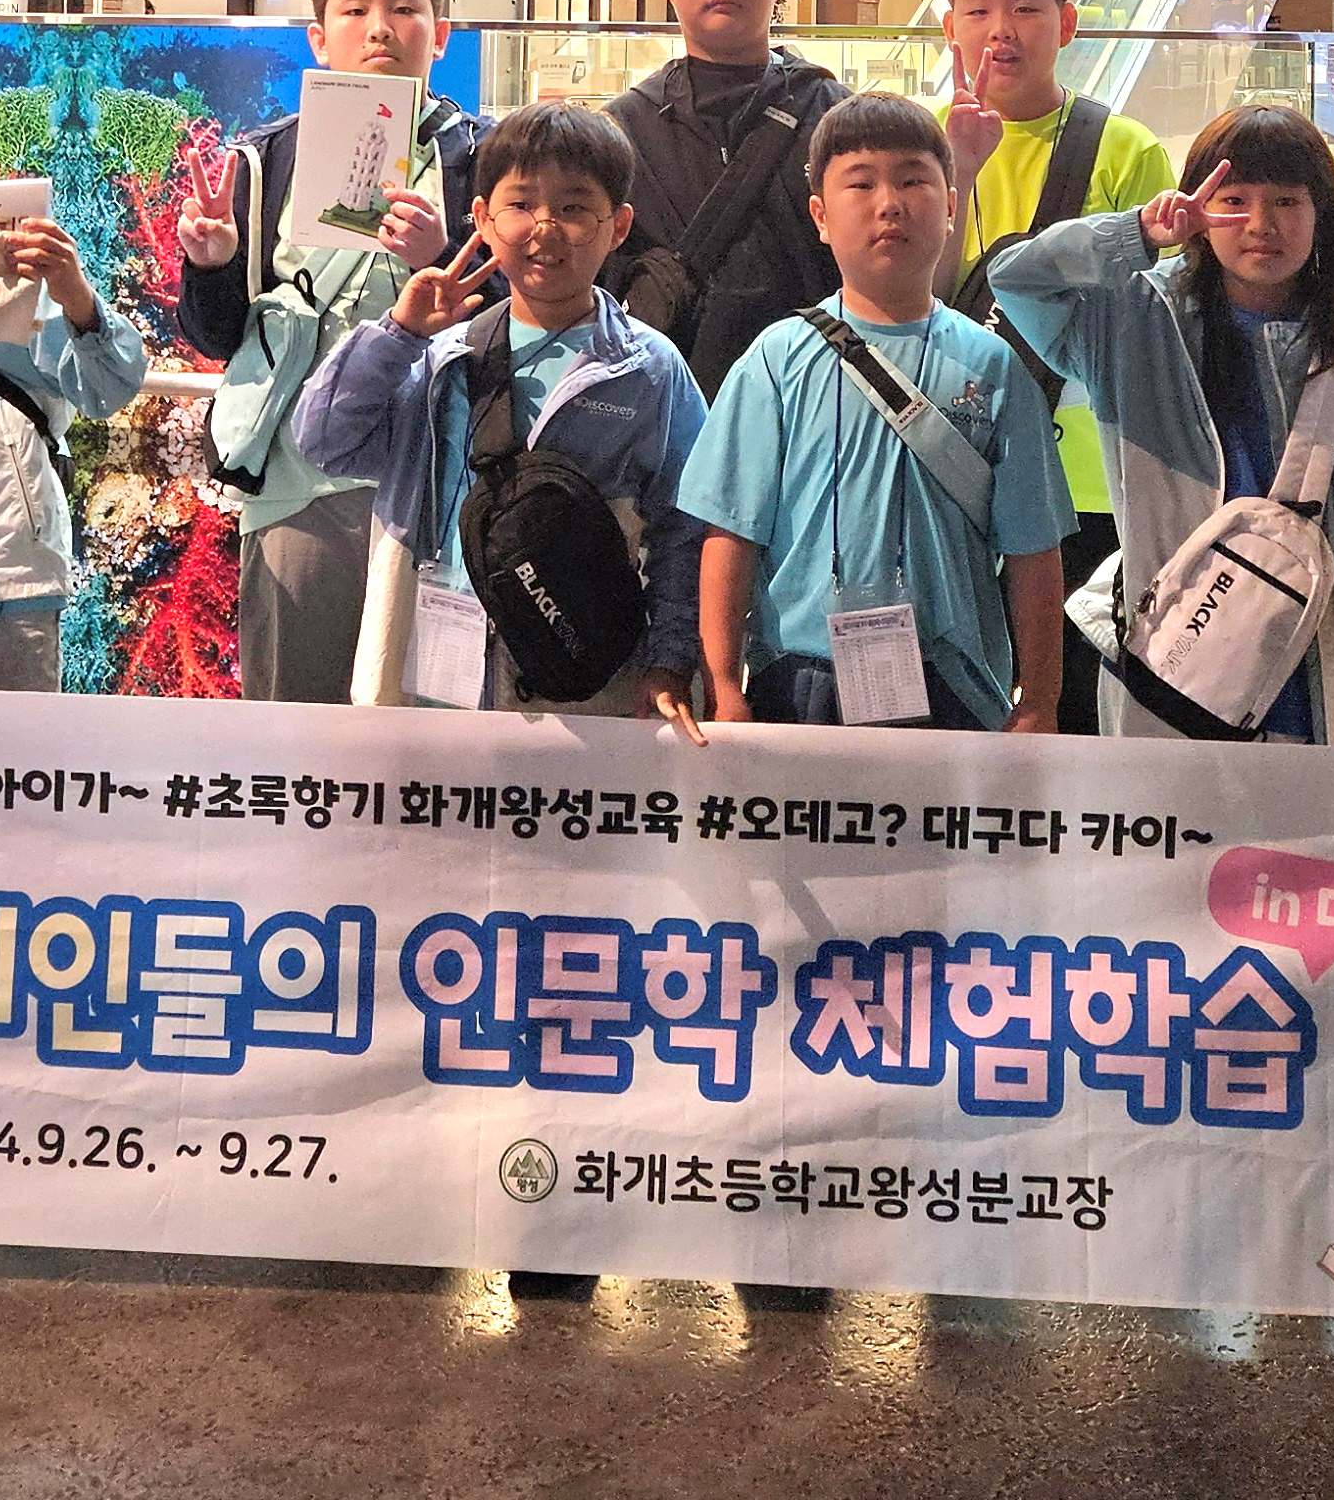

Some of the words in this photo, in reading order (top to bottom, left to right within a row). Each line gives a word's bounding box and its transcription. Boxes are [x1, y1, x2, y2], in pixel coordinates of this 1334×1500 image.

[163, 772, 385, 829] #초록향기
[399, 780, 684, 843] 화개왕성교육
[696, 795, 907, 847] #오데고?
[922, 806, 1068, 854] 대구다
[1081, 812, 1215, 860] 카이~
[1252, 873, 1301, 928] in
[400, 912, 777, 1102] 인문학
[791, 930, 1317, 1130] 체험학습
[219, 1131, 338, 1184] 9.27.
[573, 1150, 1114, 1231] 화개초등학교왕성분교장
